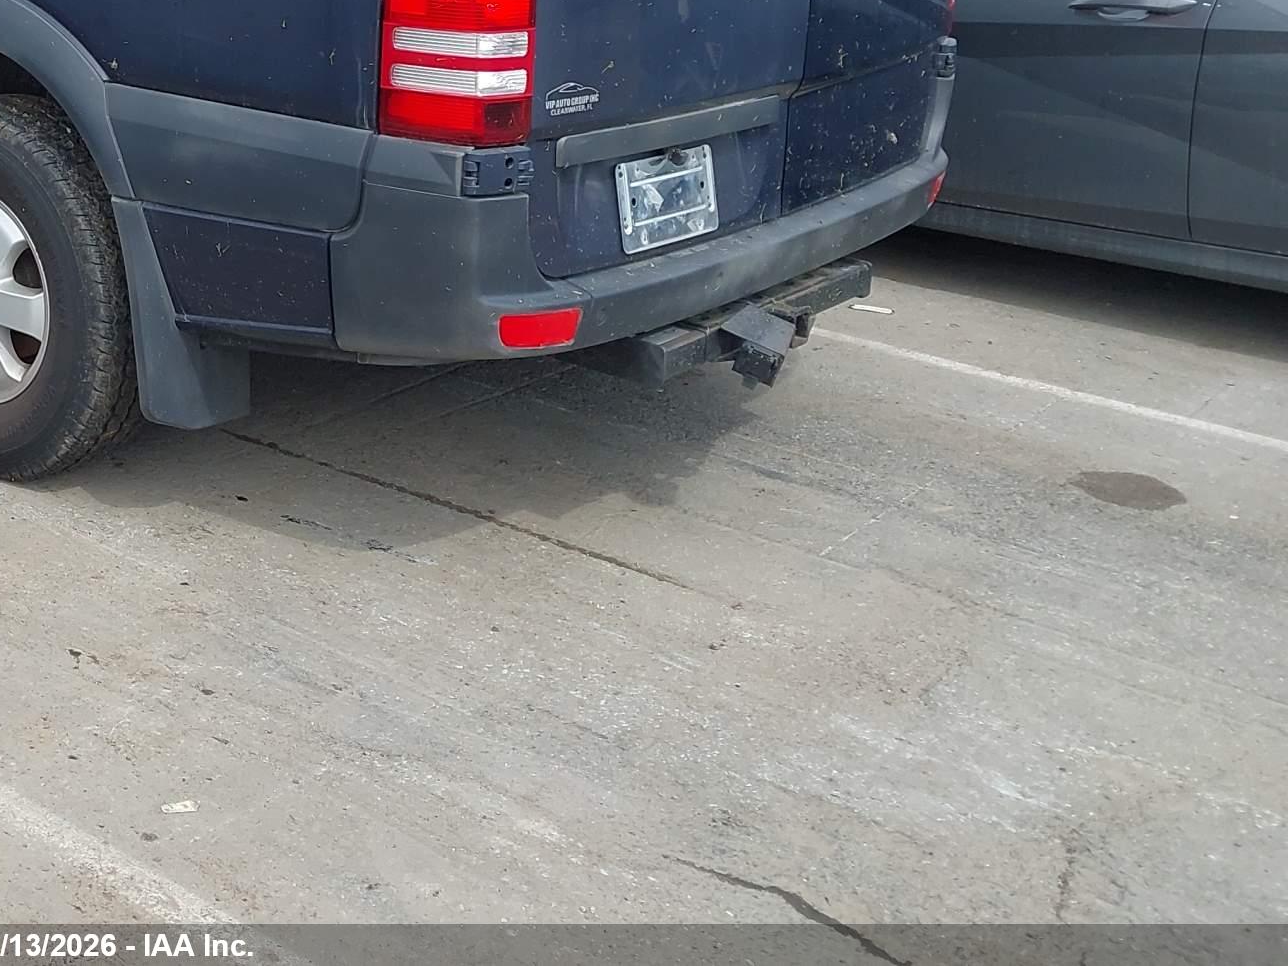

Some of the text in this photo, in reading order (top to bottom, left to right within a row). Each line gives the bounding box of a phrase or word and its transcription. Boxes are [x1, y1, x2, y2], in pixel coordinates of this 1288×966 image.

[546, 101, 555, 110] VIP
[556, 98, 570, 108] AUTO
[571, 95, 589, 106] GROUP
